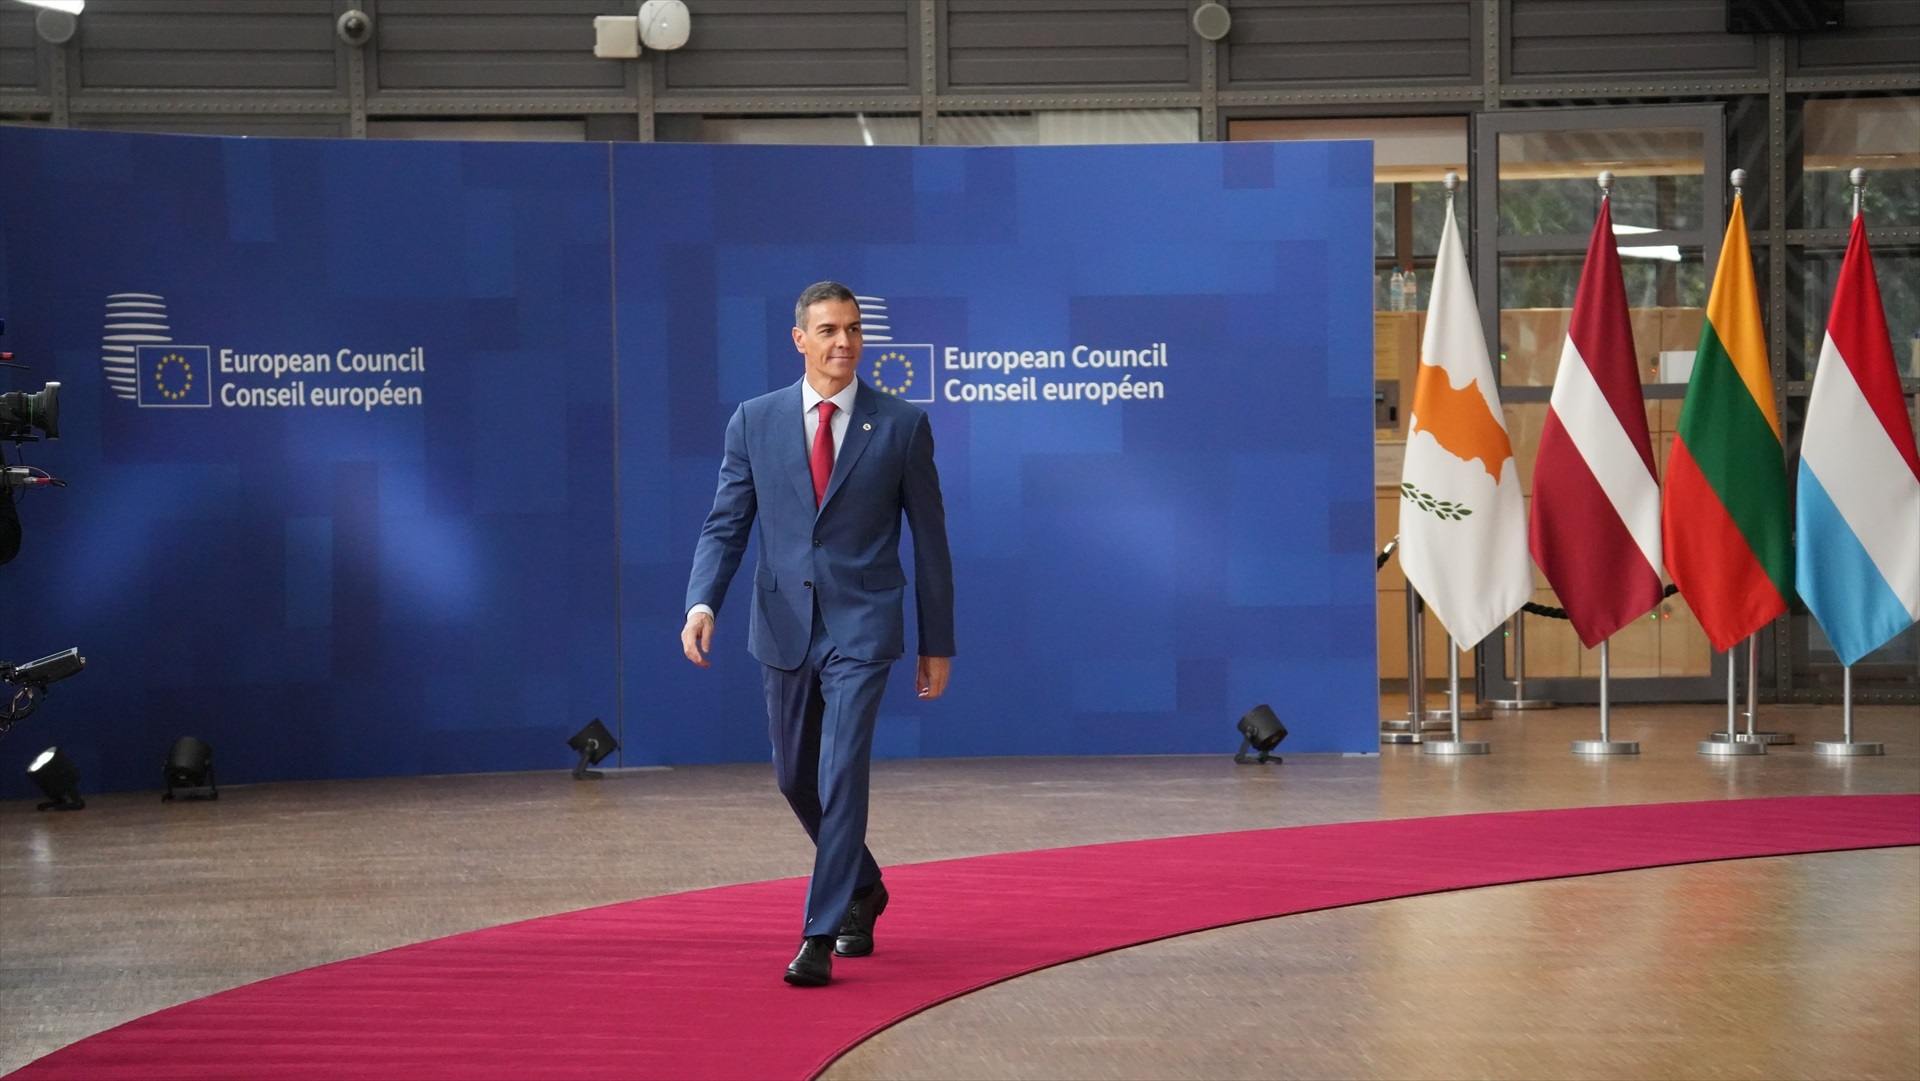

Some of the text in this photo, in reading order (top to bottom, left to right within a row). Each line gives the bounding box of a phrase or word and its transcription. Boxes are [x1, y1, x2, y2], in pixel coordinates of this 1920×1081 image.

[220, 346, 426, 379] European Council
[944, 342, 1169, 375] European Council
[220, 379, 422, 412] Conseil européen
[944, 374, 1165, 406] Conseil européen
